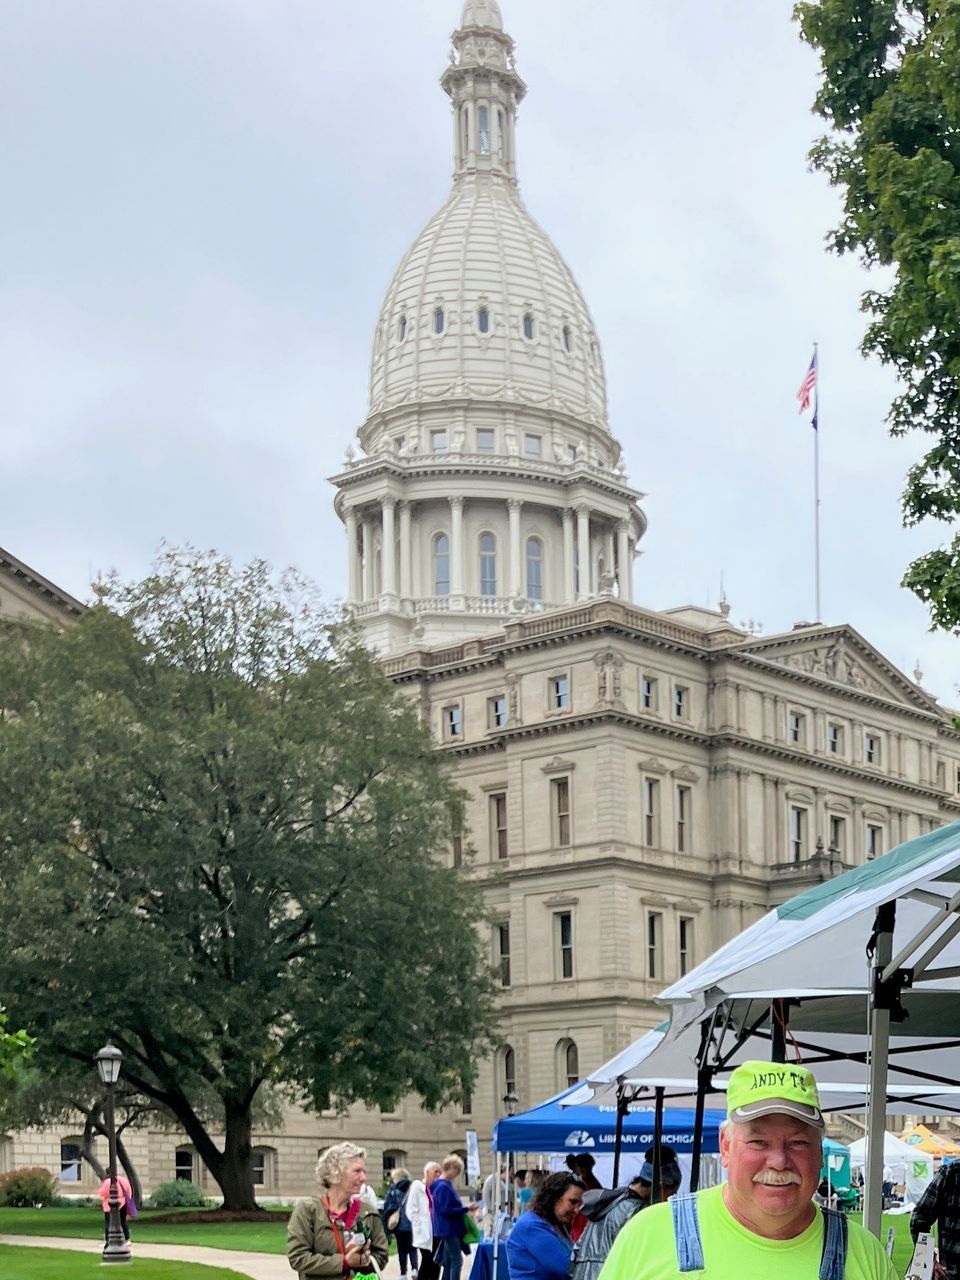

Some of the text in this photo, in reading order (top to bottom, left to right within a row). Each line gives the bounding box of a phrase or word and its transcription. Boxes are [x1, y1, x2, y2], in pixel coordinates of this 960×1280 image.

[750, 1072, 785, 1090] ANDY
[599, 1134, 638, 1144] LIBARY
[660, 1134, 704, 1144] ICHIGA
